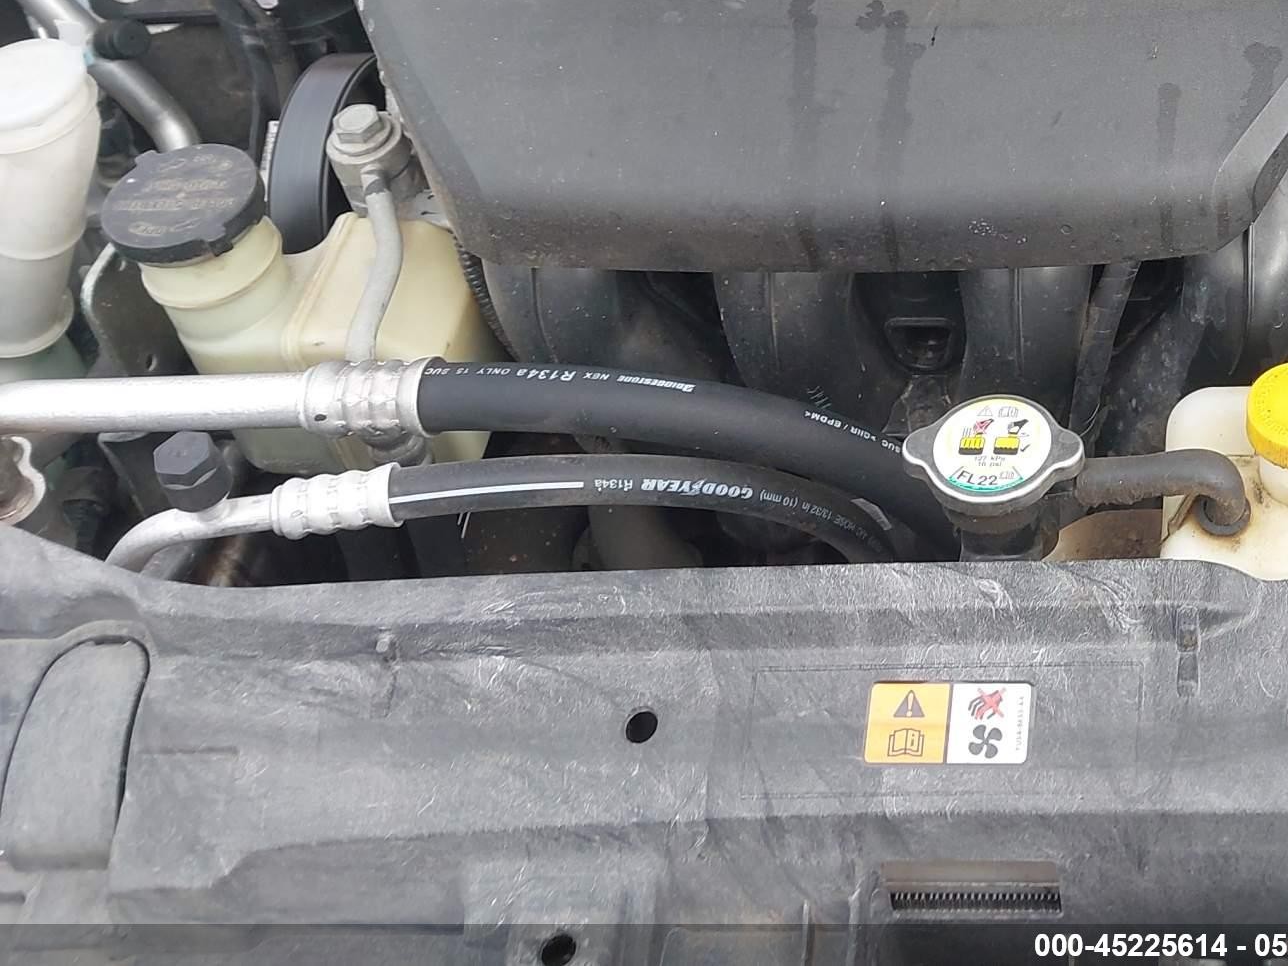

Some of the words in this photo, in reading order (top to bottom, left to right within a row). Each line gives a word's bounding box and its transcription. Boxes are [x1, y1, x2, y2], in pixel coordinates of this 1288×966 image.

[475, 367, 512, 376] ONLY
[516, 367, 577, 383] R134a
[594, 478, 634, 493] R134a
[957, 470, 998, 486] FL22
[640, 477, 754, 501] GOODYEAR
[759, 489, 782, 504] mm)
[782, 495, 799, 510] (10
